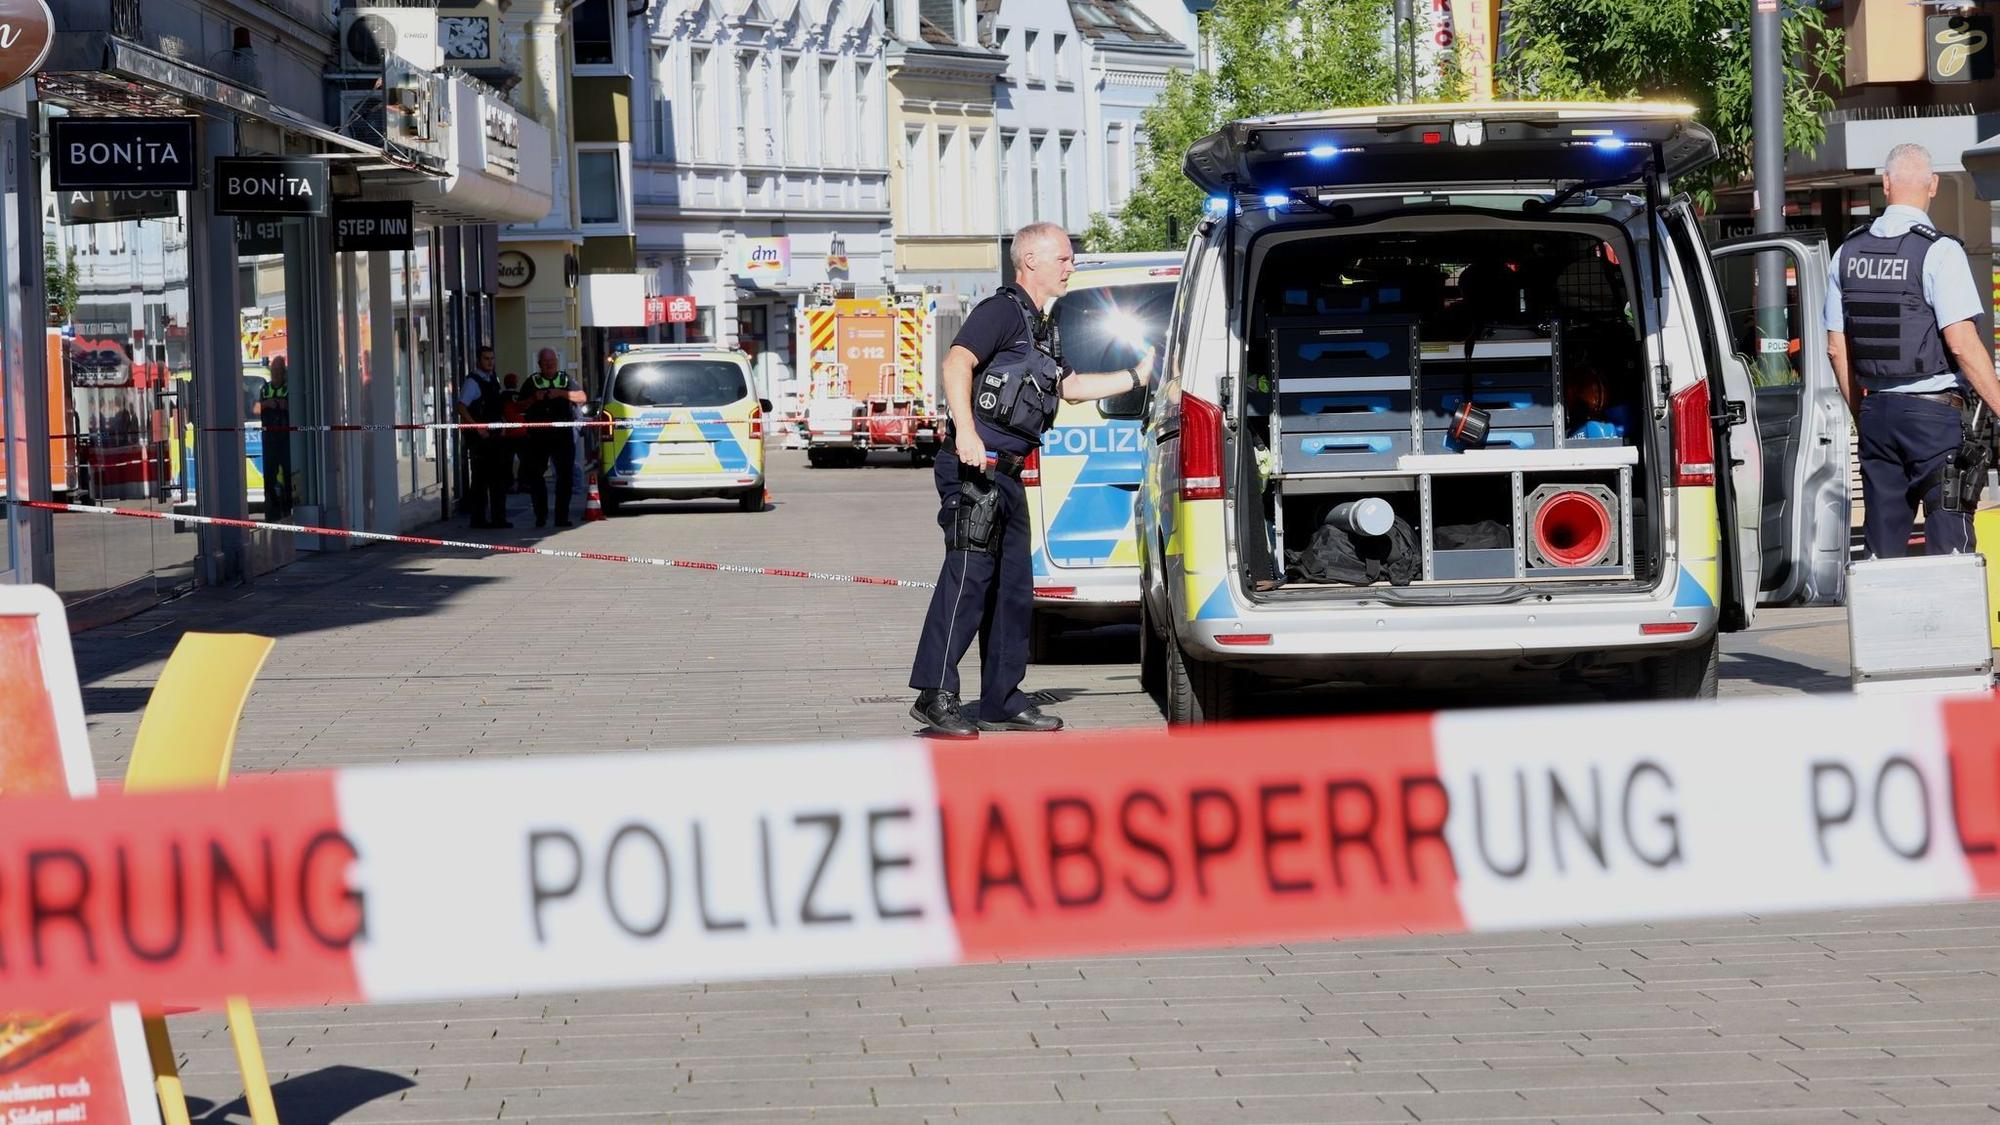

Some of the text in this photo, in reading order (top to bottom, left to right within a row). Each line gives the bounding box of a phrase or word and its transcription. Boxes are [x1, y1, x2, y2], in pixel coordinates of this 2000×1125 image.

[338, 219, 407, 236] STEP INN
[831, 233, 846, 256] dm
[752, 245, 777, 261] dm
[1847, 258, 1909, 281] POLIZEI
[669, 300, 692, 312] DER
[671, 312, 692, 321] TOUR
[862, 347, 885, 359] 112
[0, 829, 368, 970] RUNG
[527, 757, 1684, 946] POLIZEIABSPERRUNG
